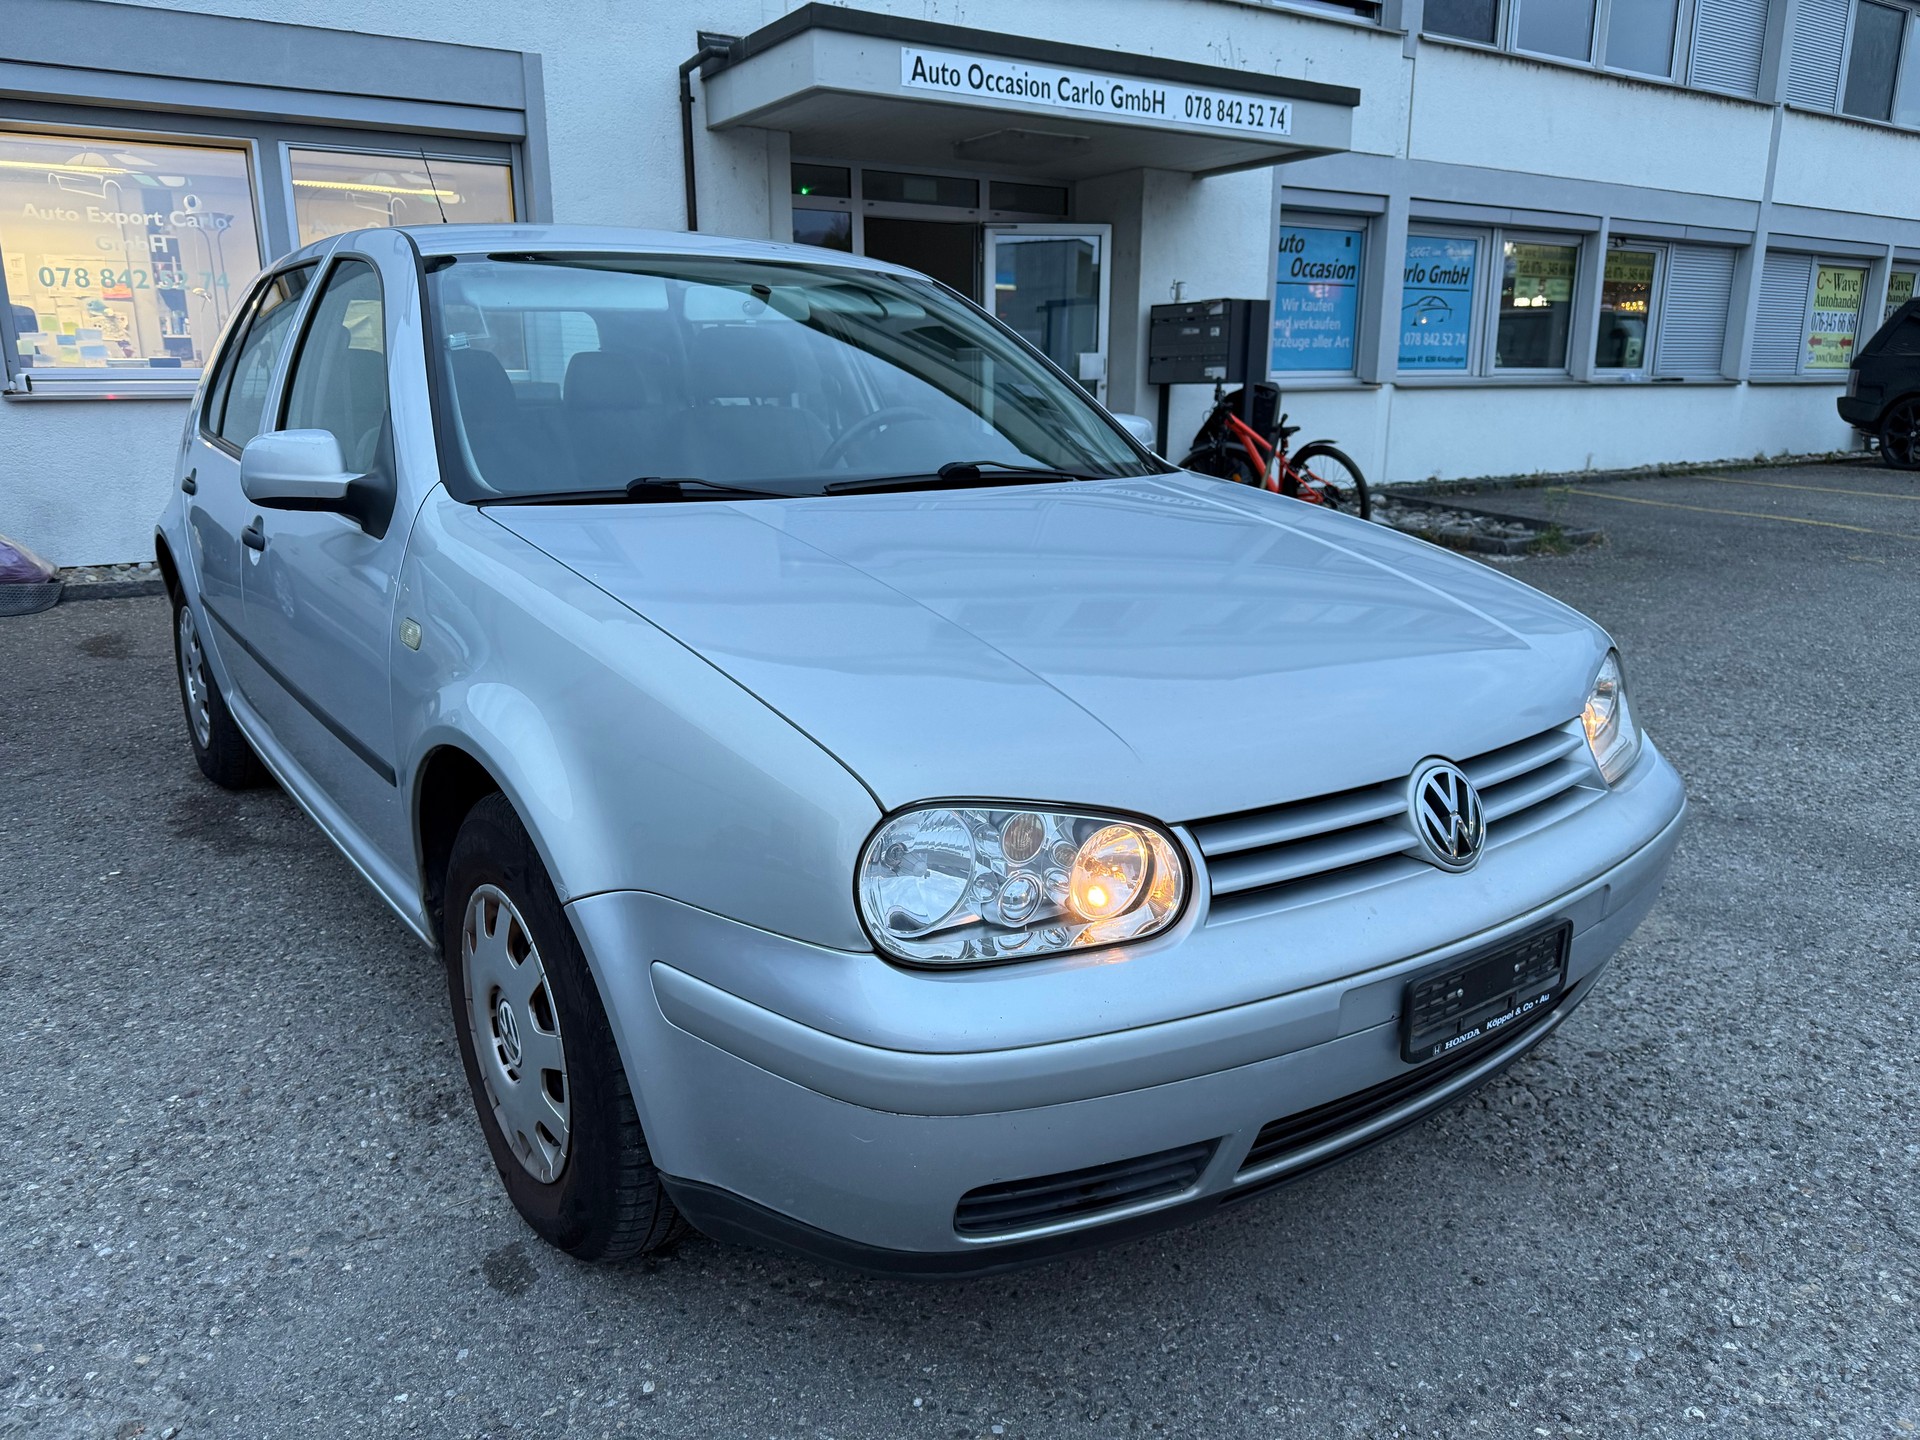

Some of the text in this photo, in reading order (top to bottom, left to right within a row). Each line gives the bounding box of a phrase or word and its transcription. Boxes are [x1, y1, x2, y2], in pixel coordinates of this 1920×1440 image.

[911, 55, 1285, 130] Auto Occasion Carlo GmbH 078 842 52 74
[22, 203, 228, 229] Auto Export Carlo
[96, 233, 168, 253] GmbH
[38, 266, 230, 291] 078 842 52 74
[1291, 257, 1356, 280] Occasion
[1429, 264, 1470, 285] GmbH
[1282, 299, 1334, 312] Wir kaufen
[1814, 293, 1859, 309] Autohandel
[1293, 317, 1340, 330] verkaufen
[1312, 335, 1332, 348] aller
[1334, 336, 1350, 348] Art
[1404, 331, 1466, 346] 078 842 52 74
[1444, 1028, 1481, 1050] HONDA
[1486, 1010, 1514, 1030] Köppel
[1515, 1006, 1521, 1016] &
[1523, 1002, 1534, 1012] Co
[1539, 993, 1550, 1004] Au
